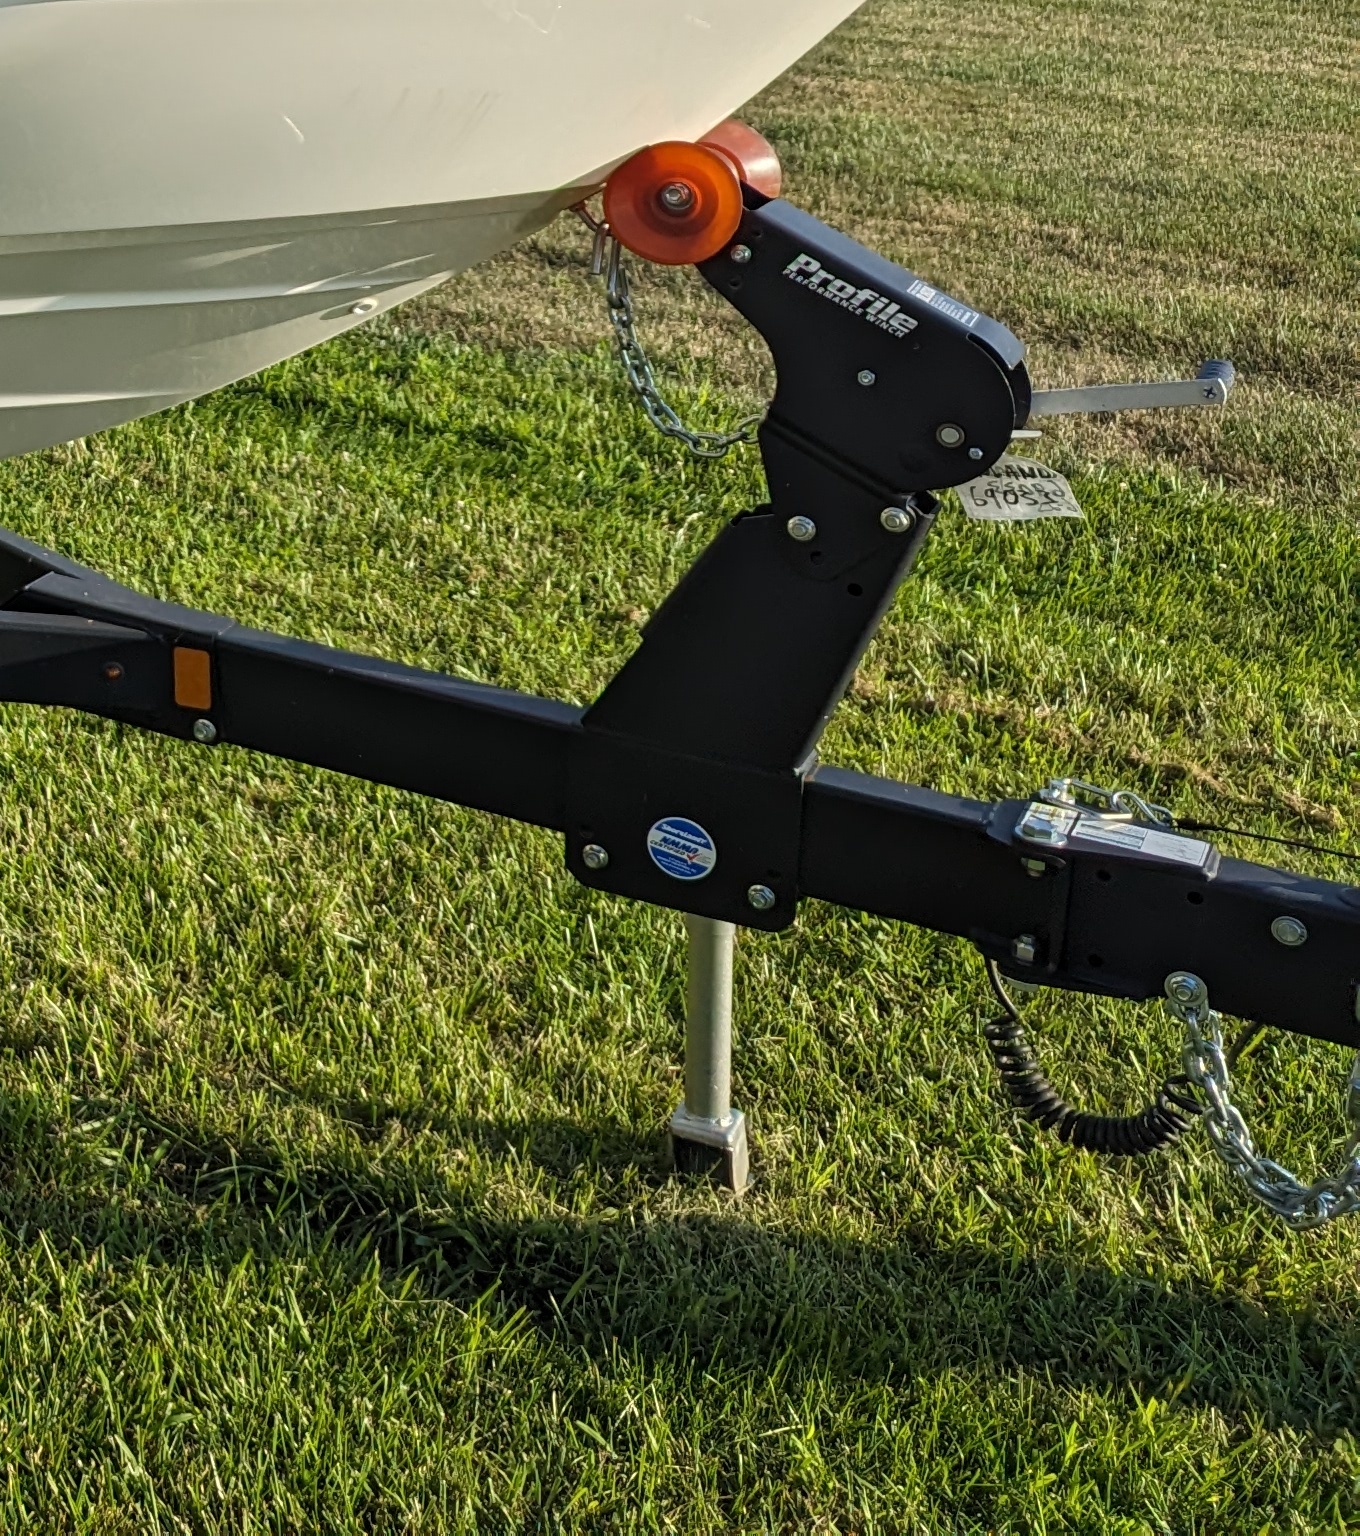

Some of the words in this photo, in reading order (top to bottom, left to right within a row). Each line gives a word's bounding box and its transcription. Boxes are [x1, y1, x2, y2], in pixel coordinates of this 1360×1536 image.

[782, 267, 865, 316] PERFORMANCE
[865, 313, 907, 339] WINCH
[786, 252, 919, 335] Profile
